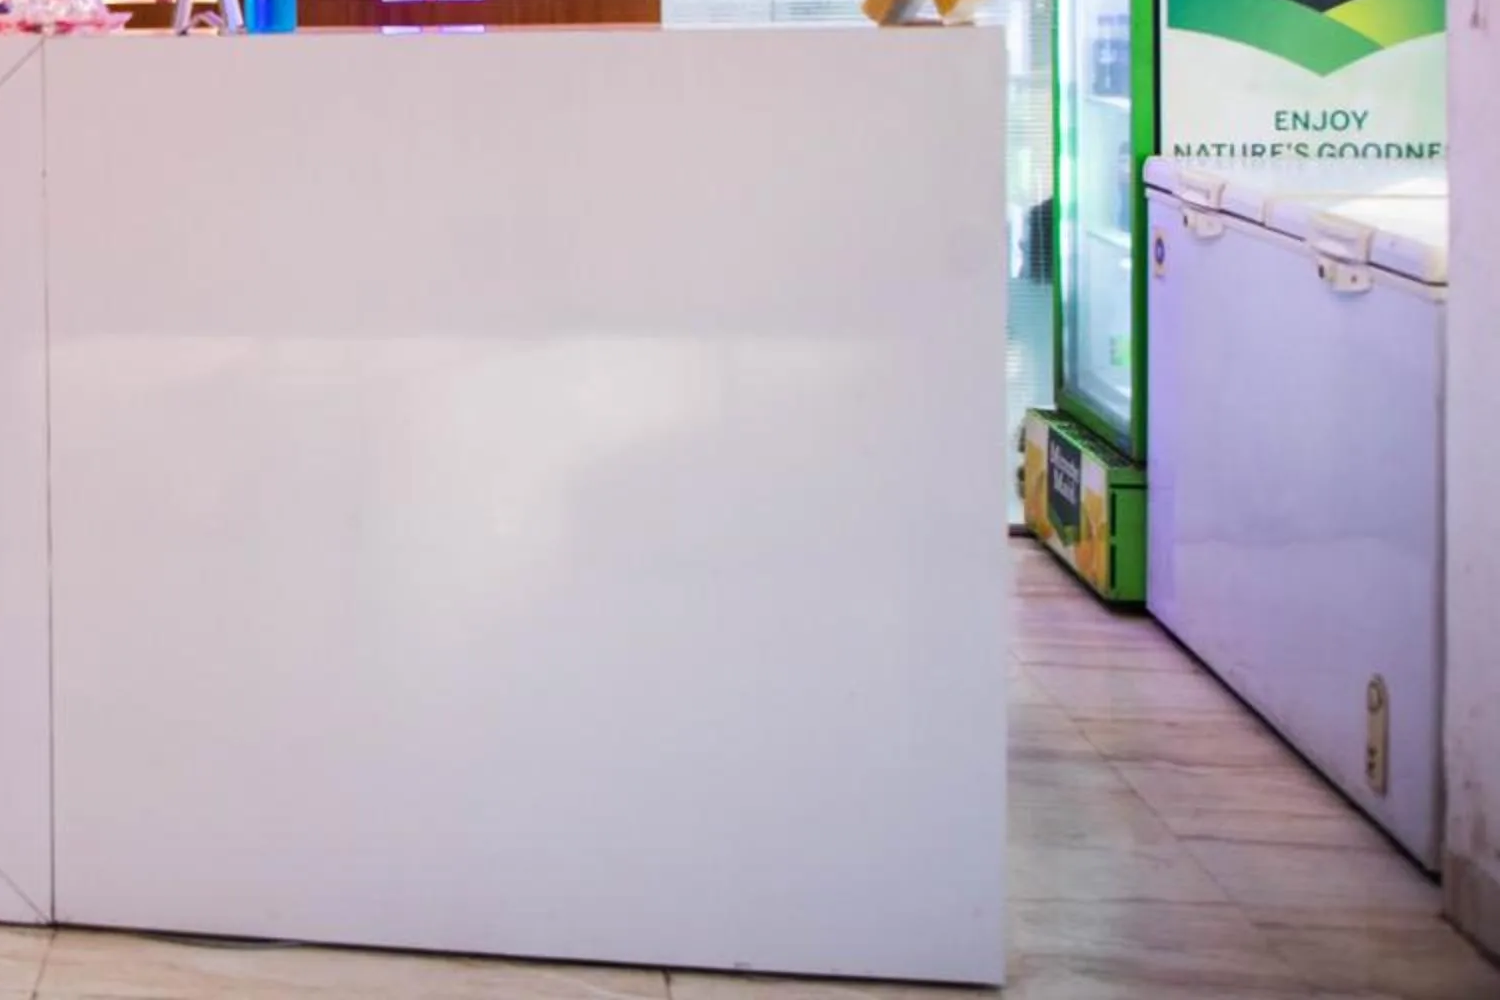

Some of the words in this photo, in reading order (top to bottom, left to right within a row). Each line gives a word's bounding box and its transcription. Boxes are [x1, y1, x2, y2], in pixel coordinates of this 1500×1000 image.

[1274, 109, 1369, 132] ENJOY
[1173, 142, 1310, 159] NATURE'S
[1317, 142, 1442, 159] GOODNE
